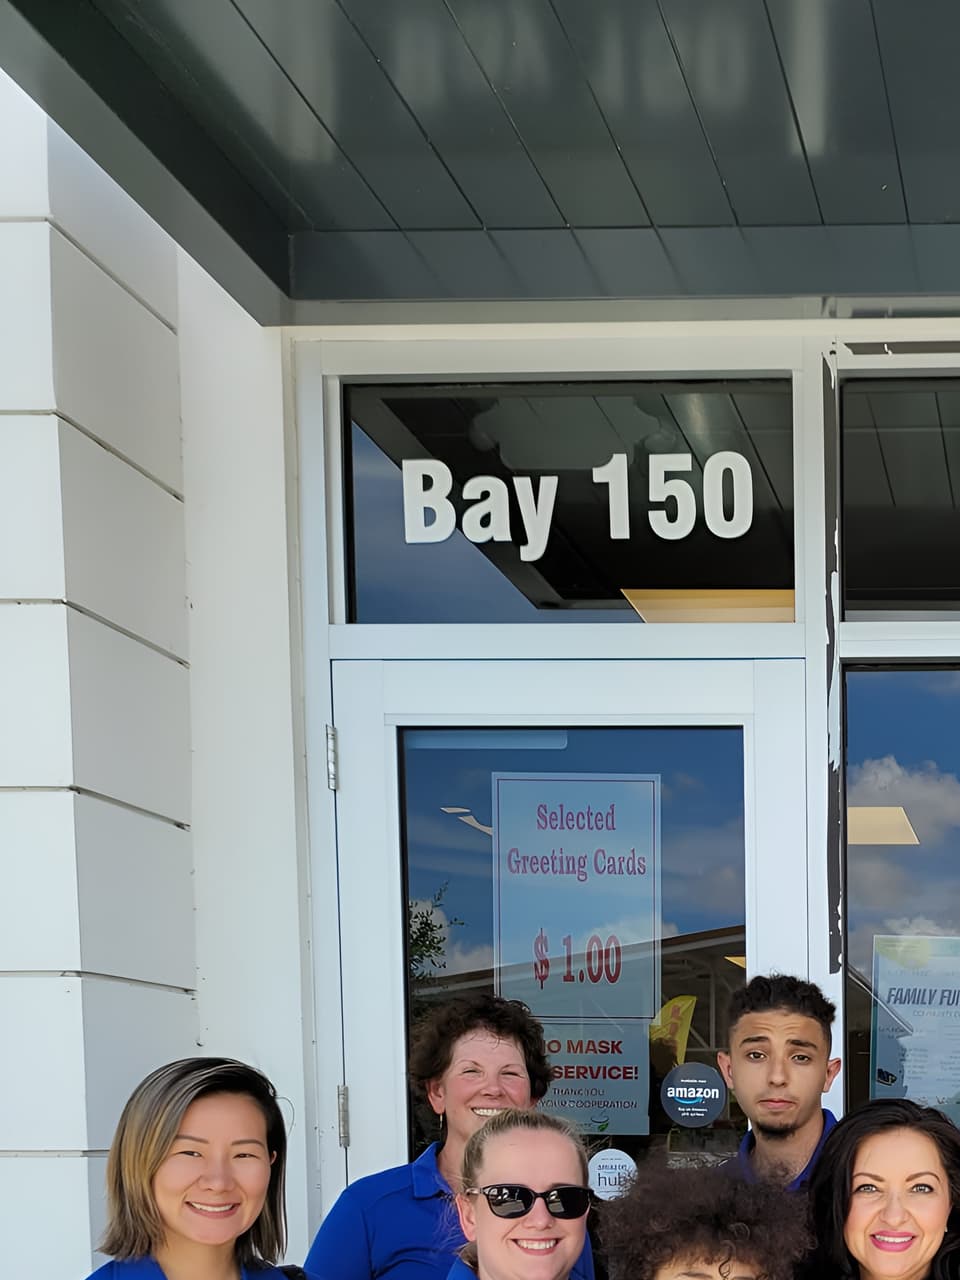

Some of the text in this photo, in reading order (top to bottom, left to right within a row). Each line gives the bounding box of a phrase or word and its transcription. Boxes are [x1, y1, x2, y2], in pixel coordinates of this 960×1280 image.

[401, 450, 754, 562] Bay 150
[536, 803, 616, 831] Selected
[507, 847, 647, 882] Greeting Cards
[562, 934, 622, 984] 1.00
[886, 986, 938, 1006] FAMILY
[566, 1040, 622, 1055] MASK
[552, 1065, 639, 1080] SERVICE!
[667, 1087, 720, 1099] amazon
